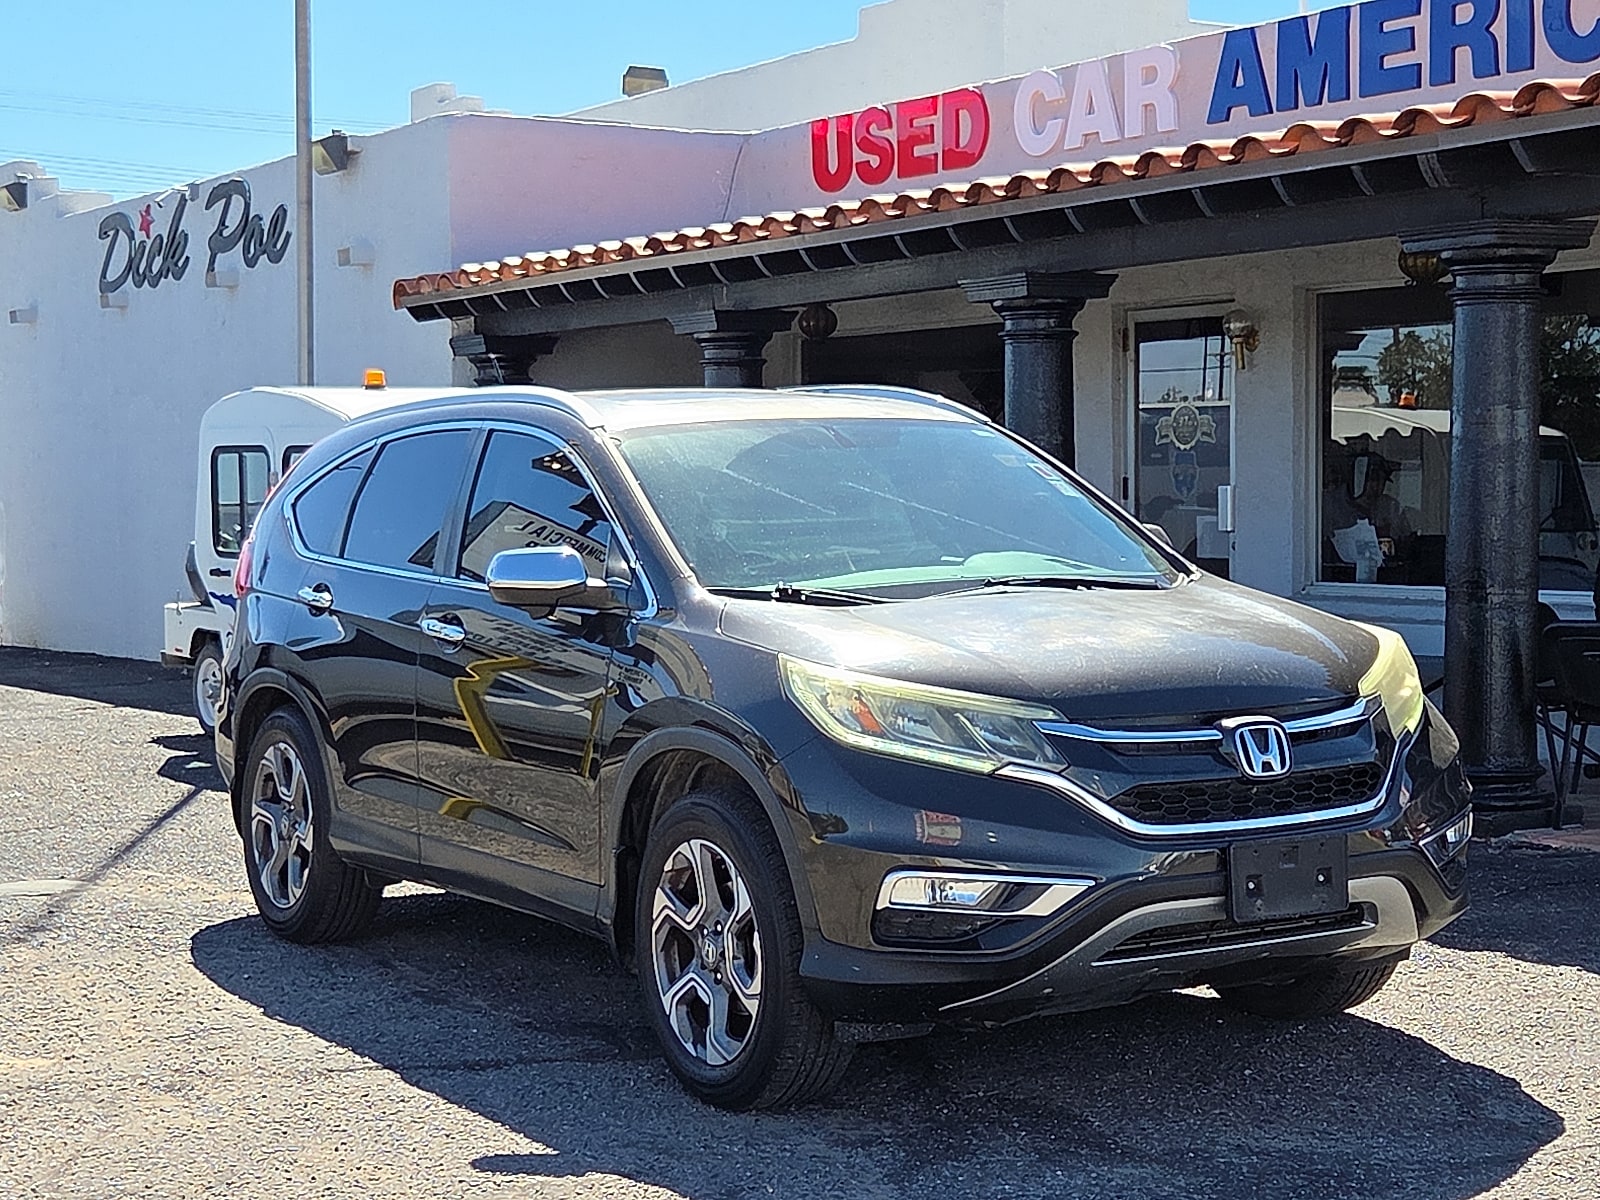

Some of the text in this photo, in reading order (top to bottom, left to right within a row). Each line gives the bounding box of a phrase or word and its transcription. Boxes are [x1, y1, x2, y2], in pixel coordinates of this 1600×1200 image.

[811, 86, 990, 193] USED
[1013, 43, 1180, 157] CAR
[98, 176, 292, 294] Dick Poe
